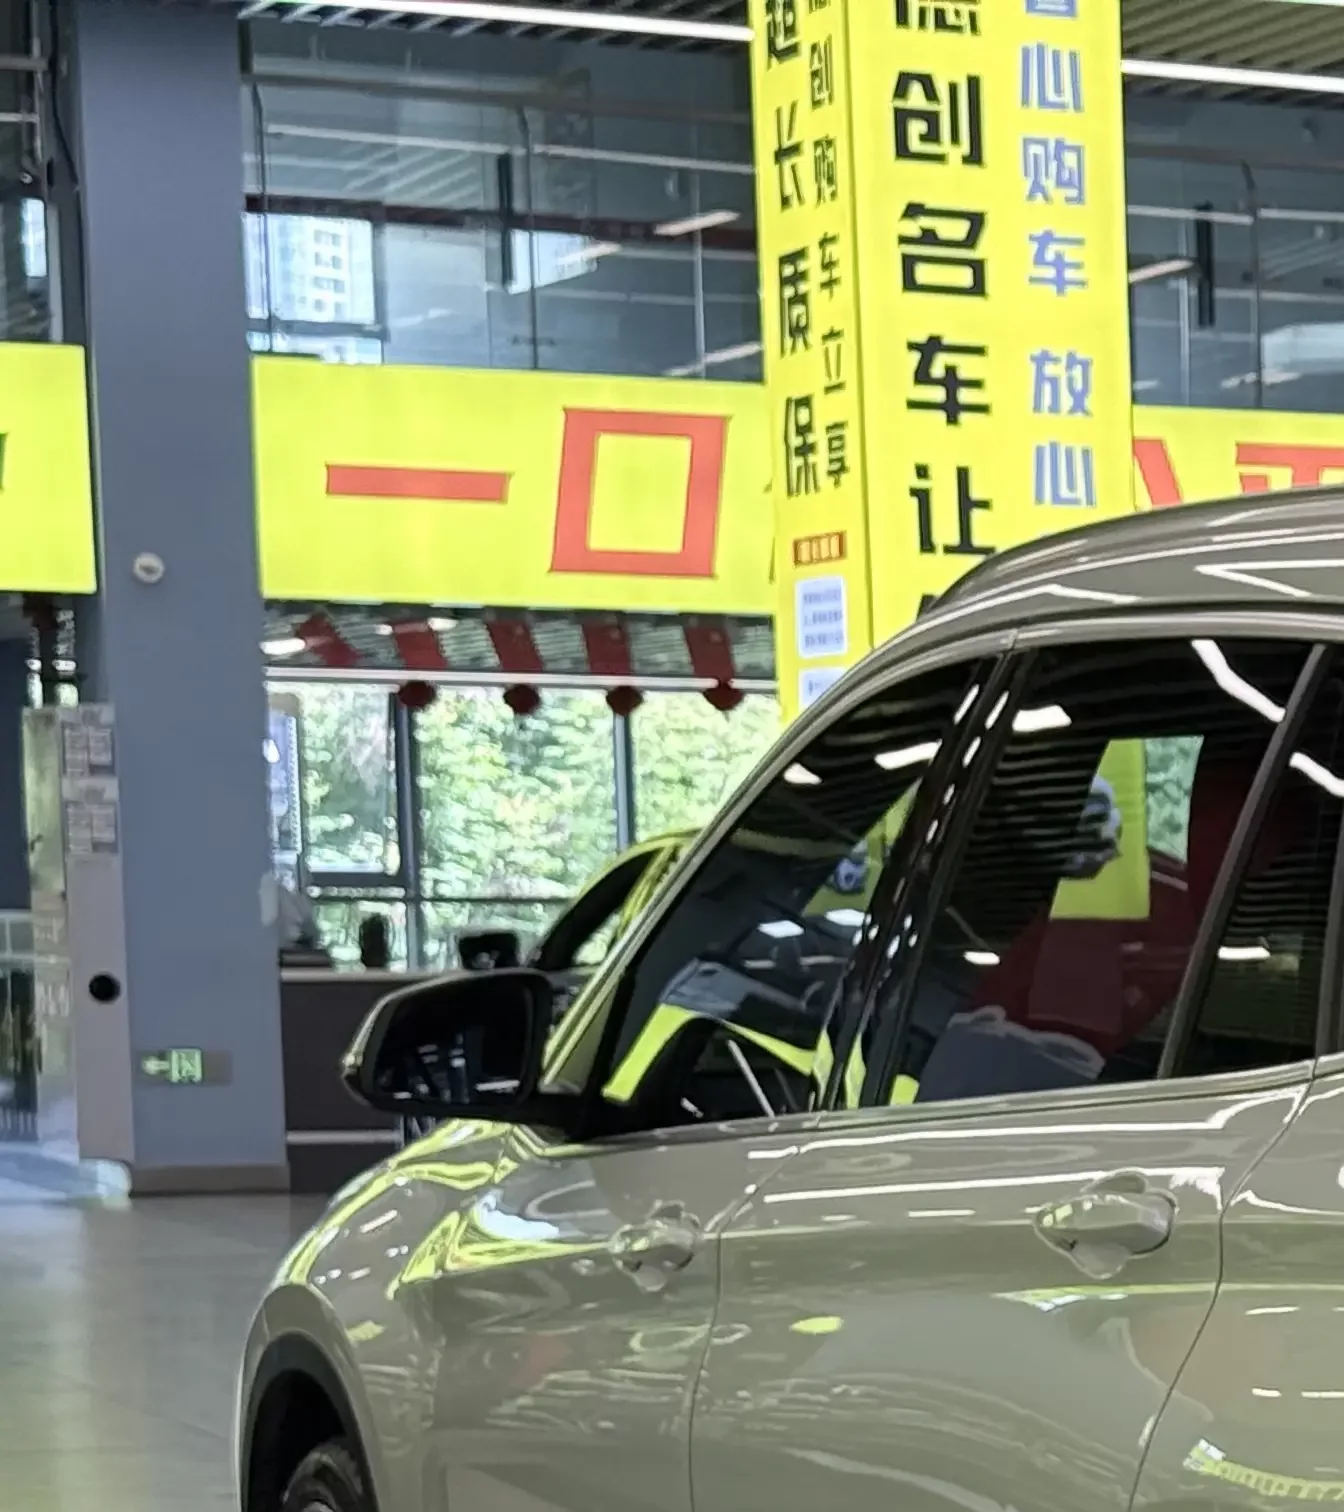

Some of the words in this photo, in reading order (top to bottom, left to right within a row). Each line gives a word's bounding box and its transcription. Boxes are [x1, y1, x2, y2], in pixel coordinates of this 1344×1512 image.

[807, 0, 850, 489] 创购车立享
[892, 0, 996, 622] 创名车让
[1020, 0, 1088, 296] 心购车
